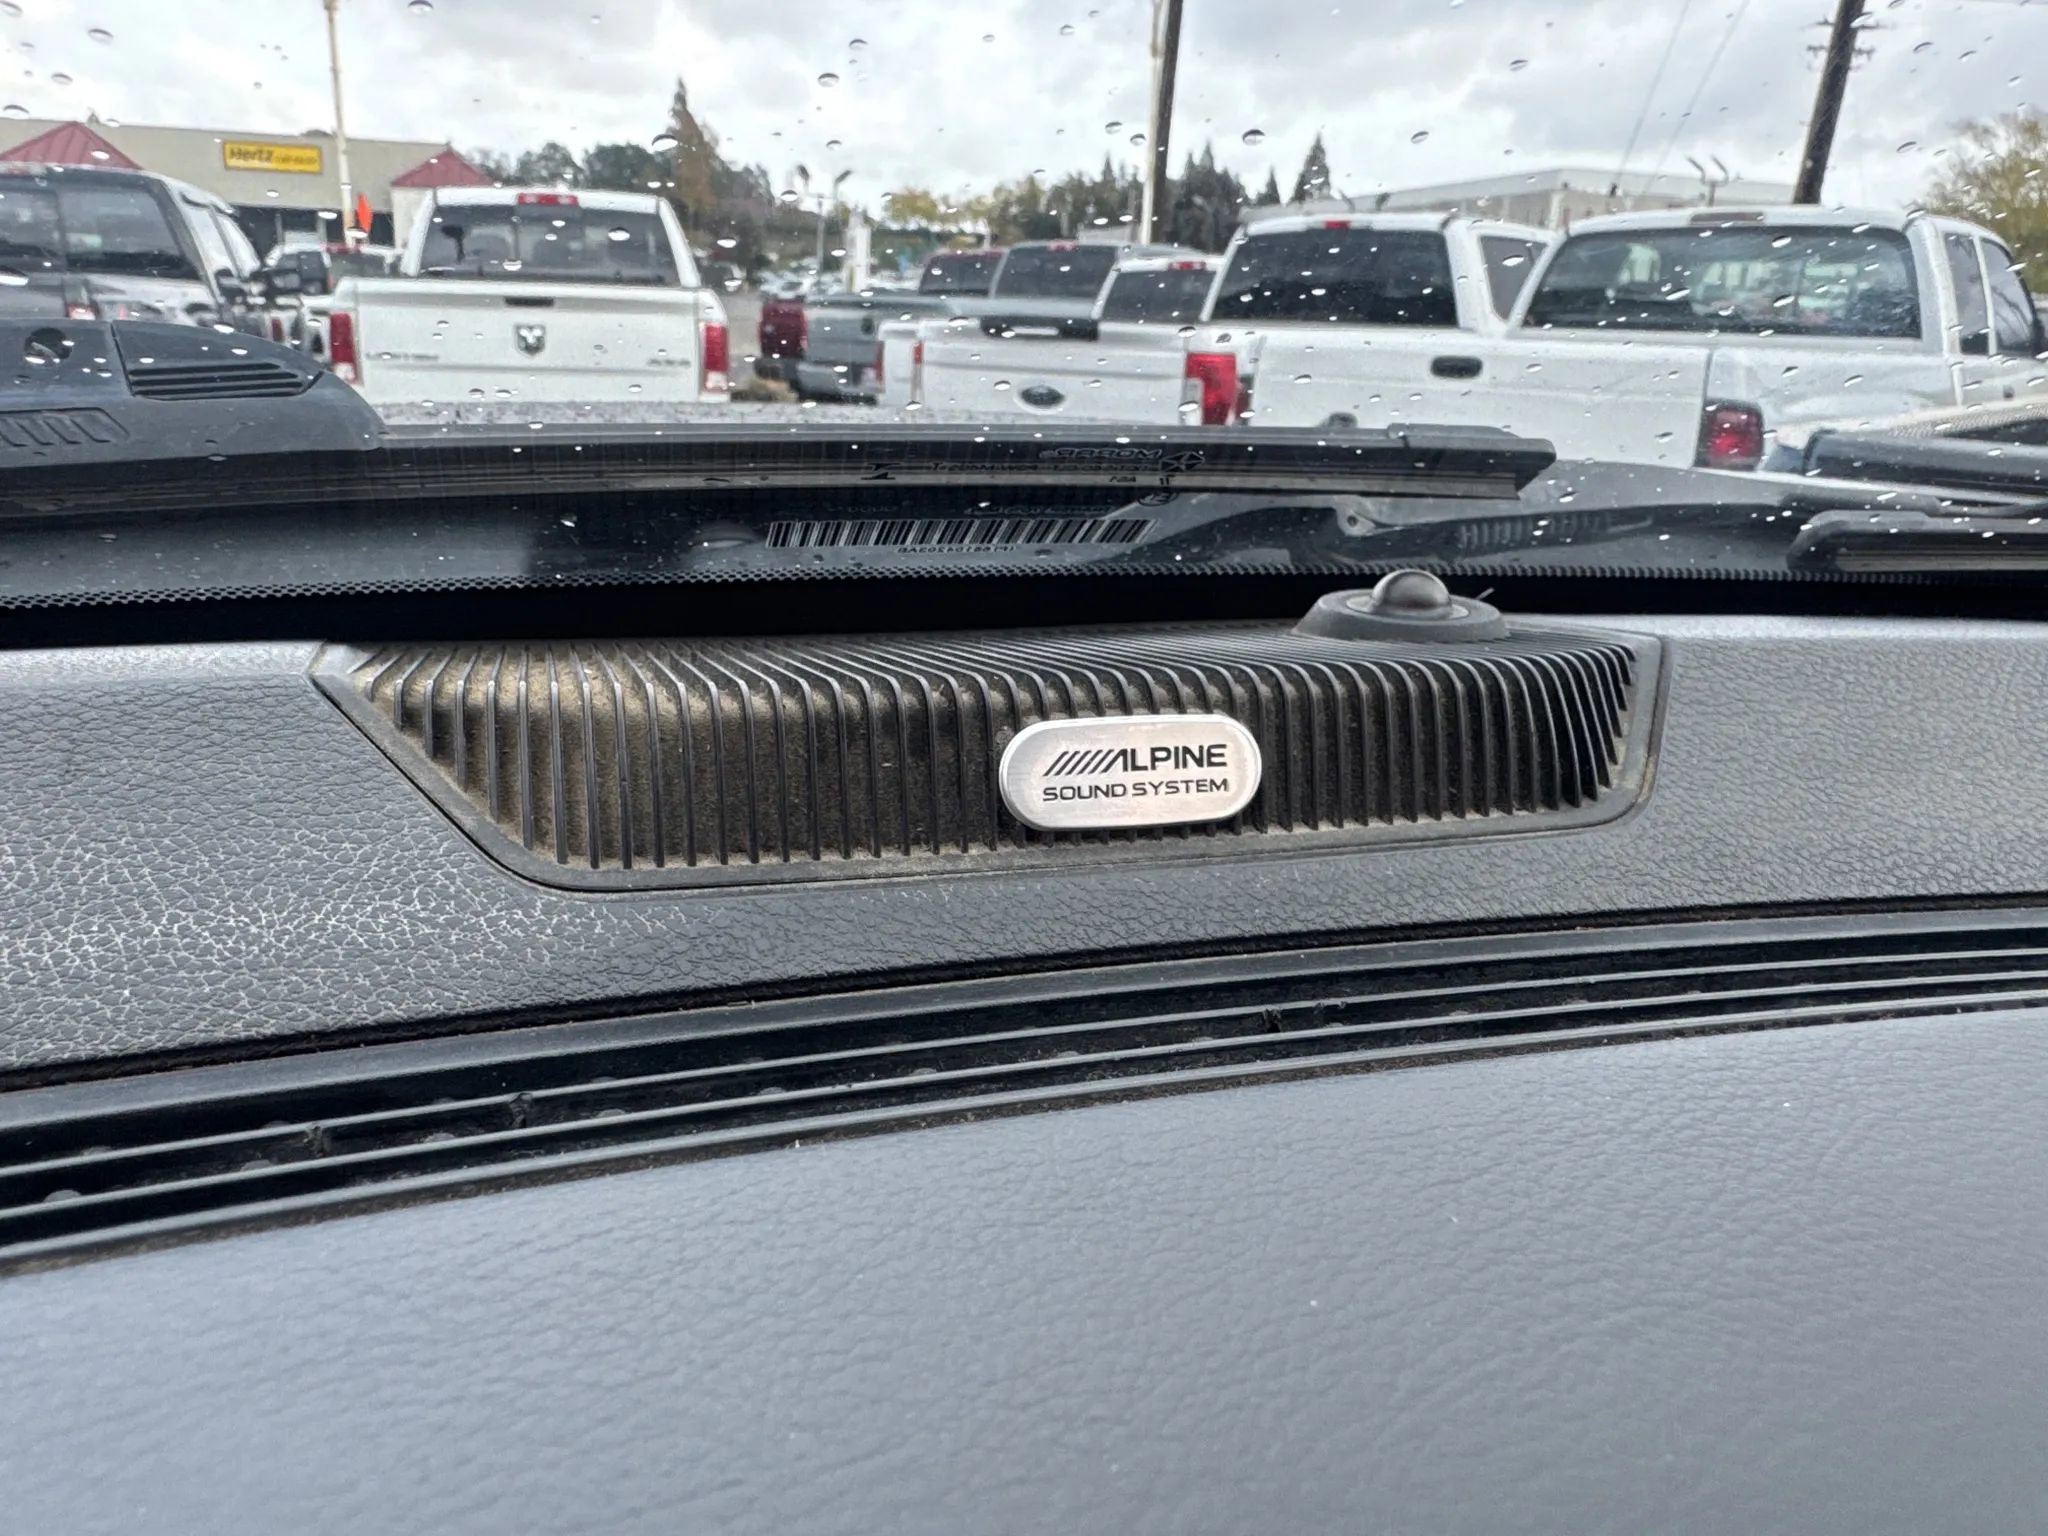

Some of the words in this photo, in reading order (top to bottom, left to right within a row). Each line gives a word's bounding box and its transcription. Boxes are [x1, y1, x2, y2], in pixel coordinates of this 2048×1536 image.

[230, 146, 273, 163] Hertz
[1101, 744, 1228, 774] ALPINE
[1042, 783, 1127, 802] SOUND
[1131, 778, 1229, 797] SYSTEM
